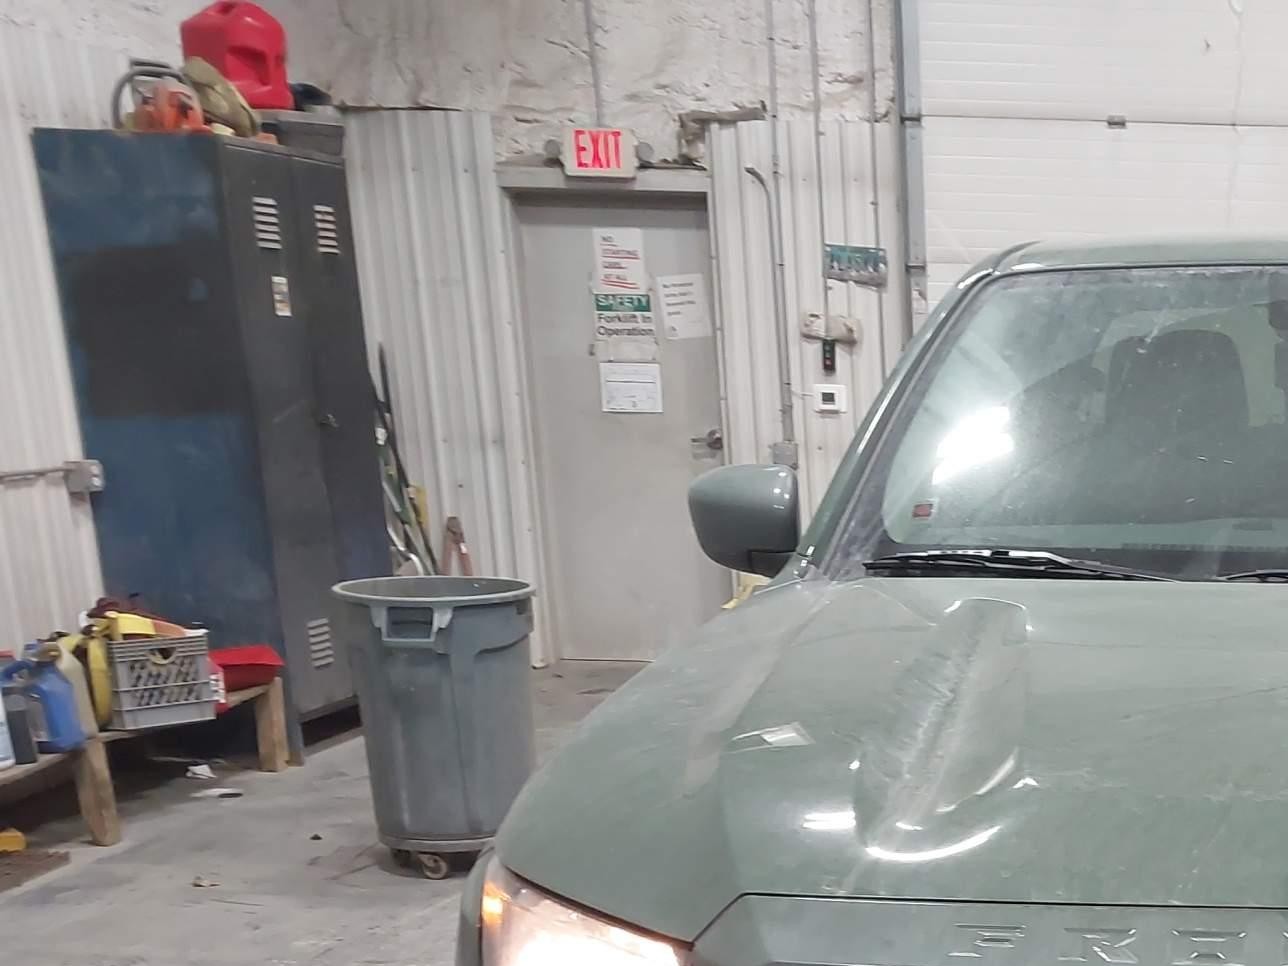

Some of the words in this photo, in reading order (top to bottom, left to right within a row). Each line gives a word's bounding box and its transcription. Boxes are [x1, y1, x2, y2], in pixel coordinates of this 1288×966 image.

[575, 131, 622, 168] EXIT
[596, 295, 648, 307] SAFETY
[597, 313, 641, 324] Forklift
[596, 325, 656, 337] Operation
